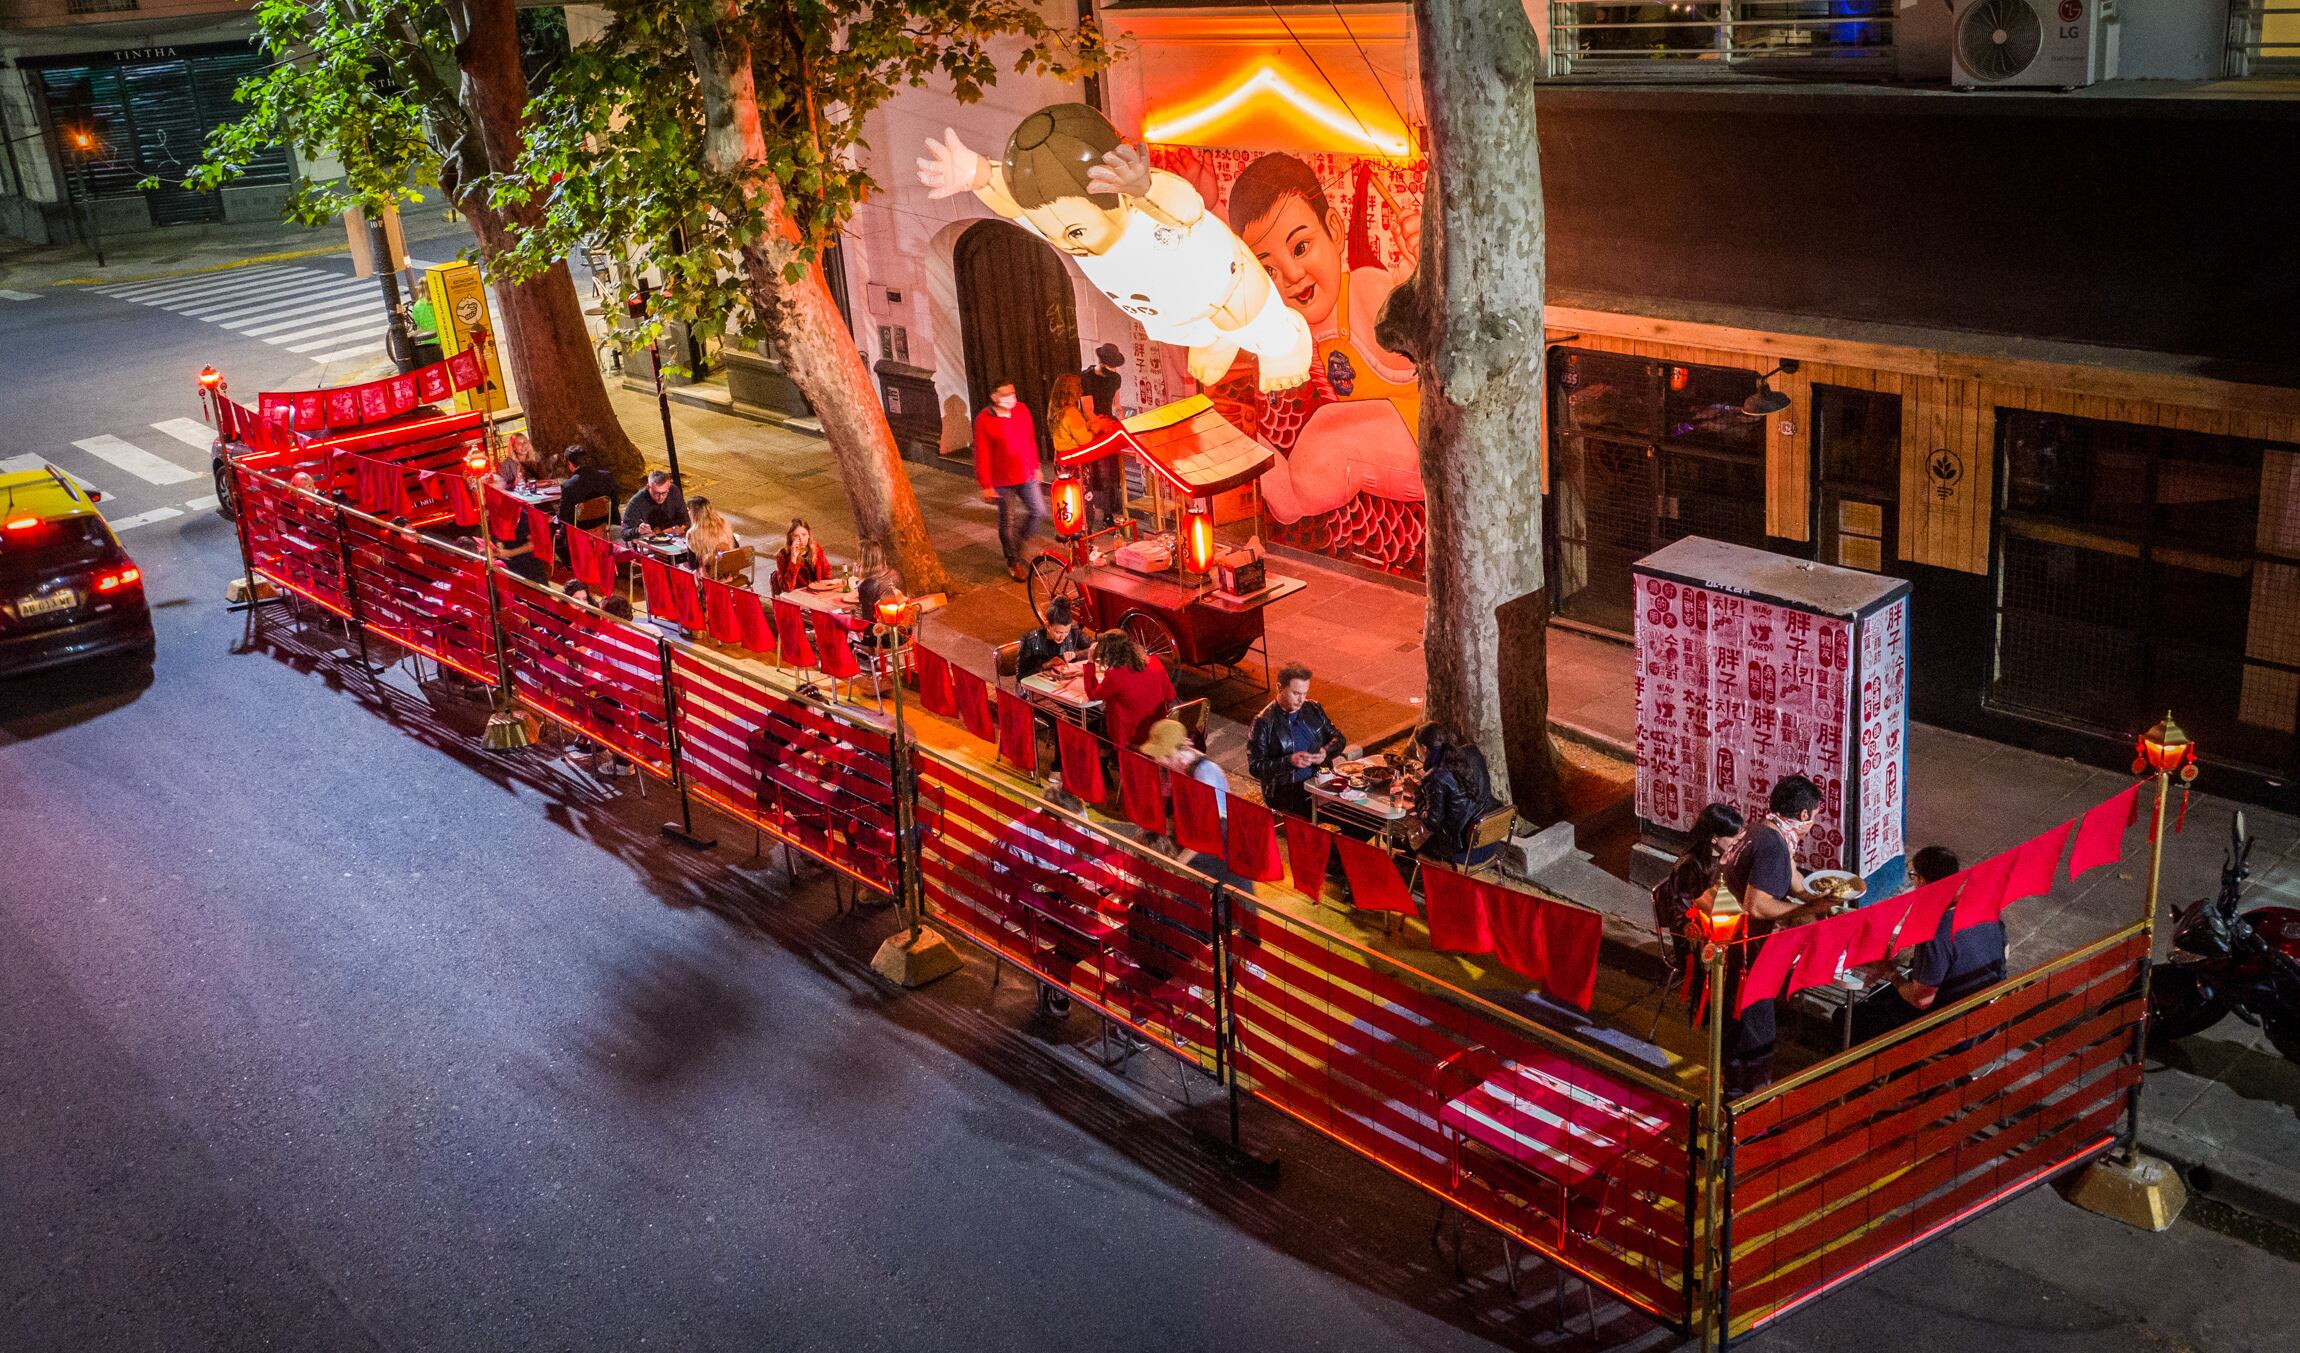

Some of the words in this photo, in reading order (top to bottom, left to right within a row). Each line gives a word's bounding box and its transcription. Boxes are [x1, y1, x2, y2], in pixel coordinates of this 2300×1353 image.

[2060, 27, 2079, 38] LG
[114, 48, 176, 60] TINTHA
[1712, 596, 1744, 618] 치킨
[1785, 610, 1811, 661] 胖子
[1887, 601, 1902, 655] 胖子
[1665, 634, 1678, 648] 수
[1747, 639, 1774, 651] GORDO
[1716, 647, 1739, 694] 胖子
[1781, 662, 1813, 686] 치킨
[1715, 699, 1745, 721] 치킨
[1751, 706, 1776, 755] 胖子
[1816, 723, 1841, 772] 胖子
[1864, 821, 1879, 872] 胖子
